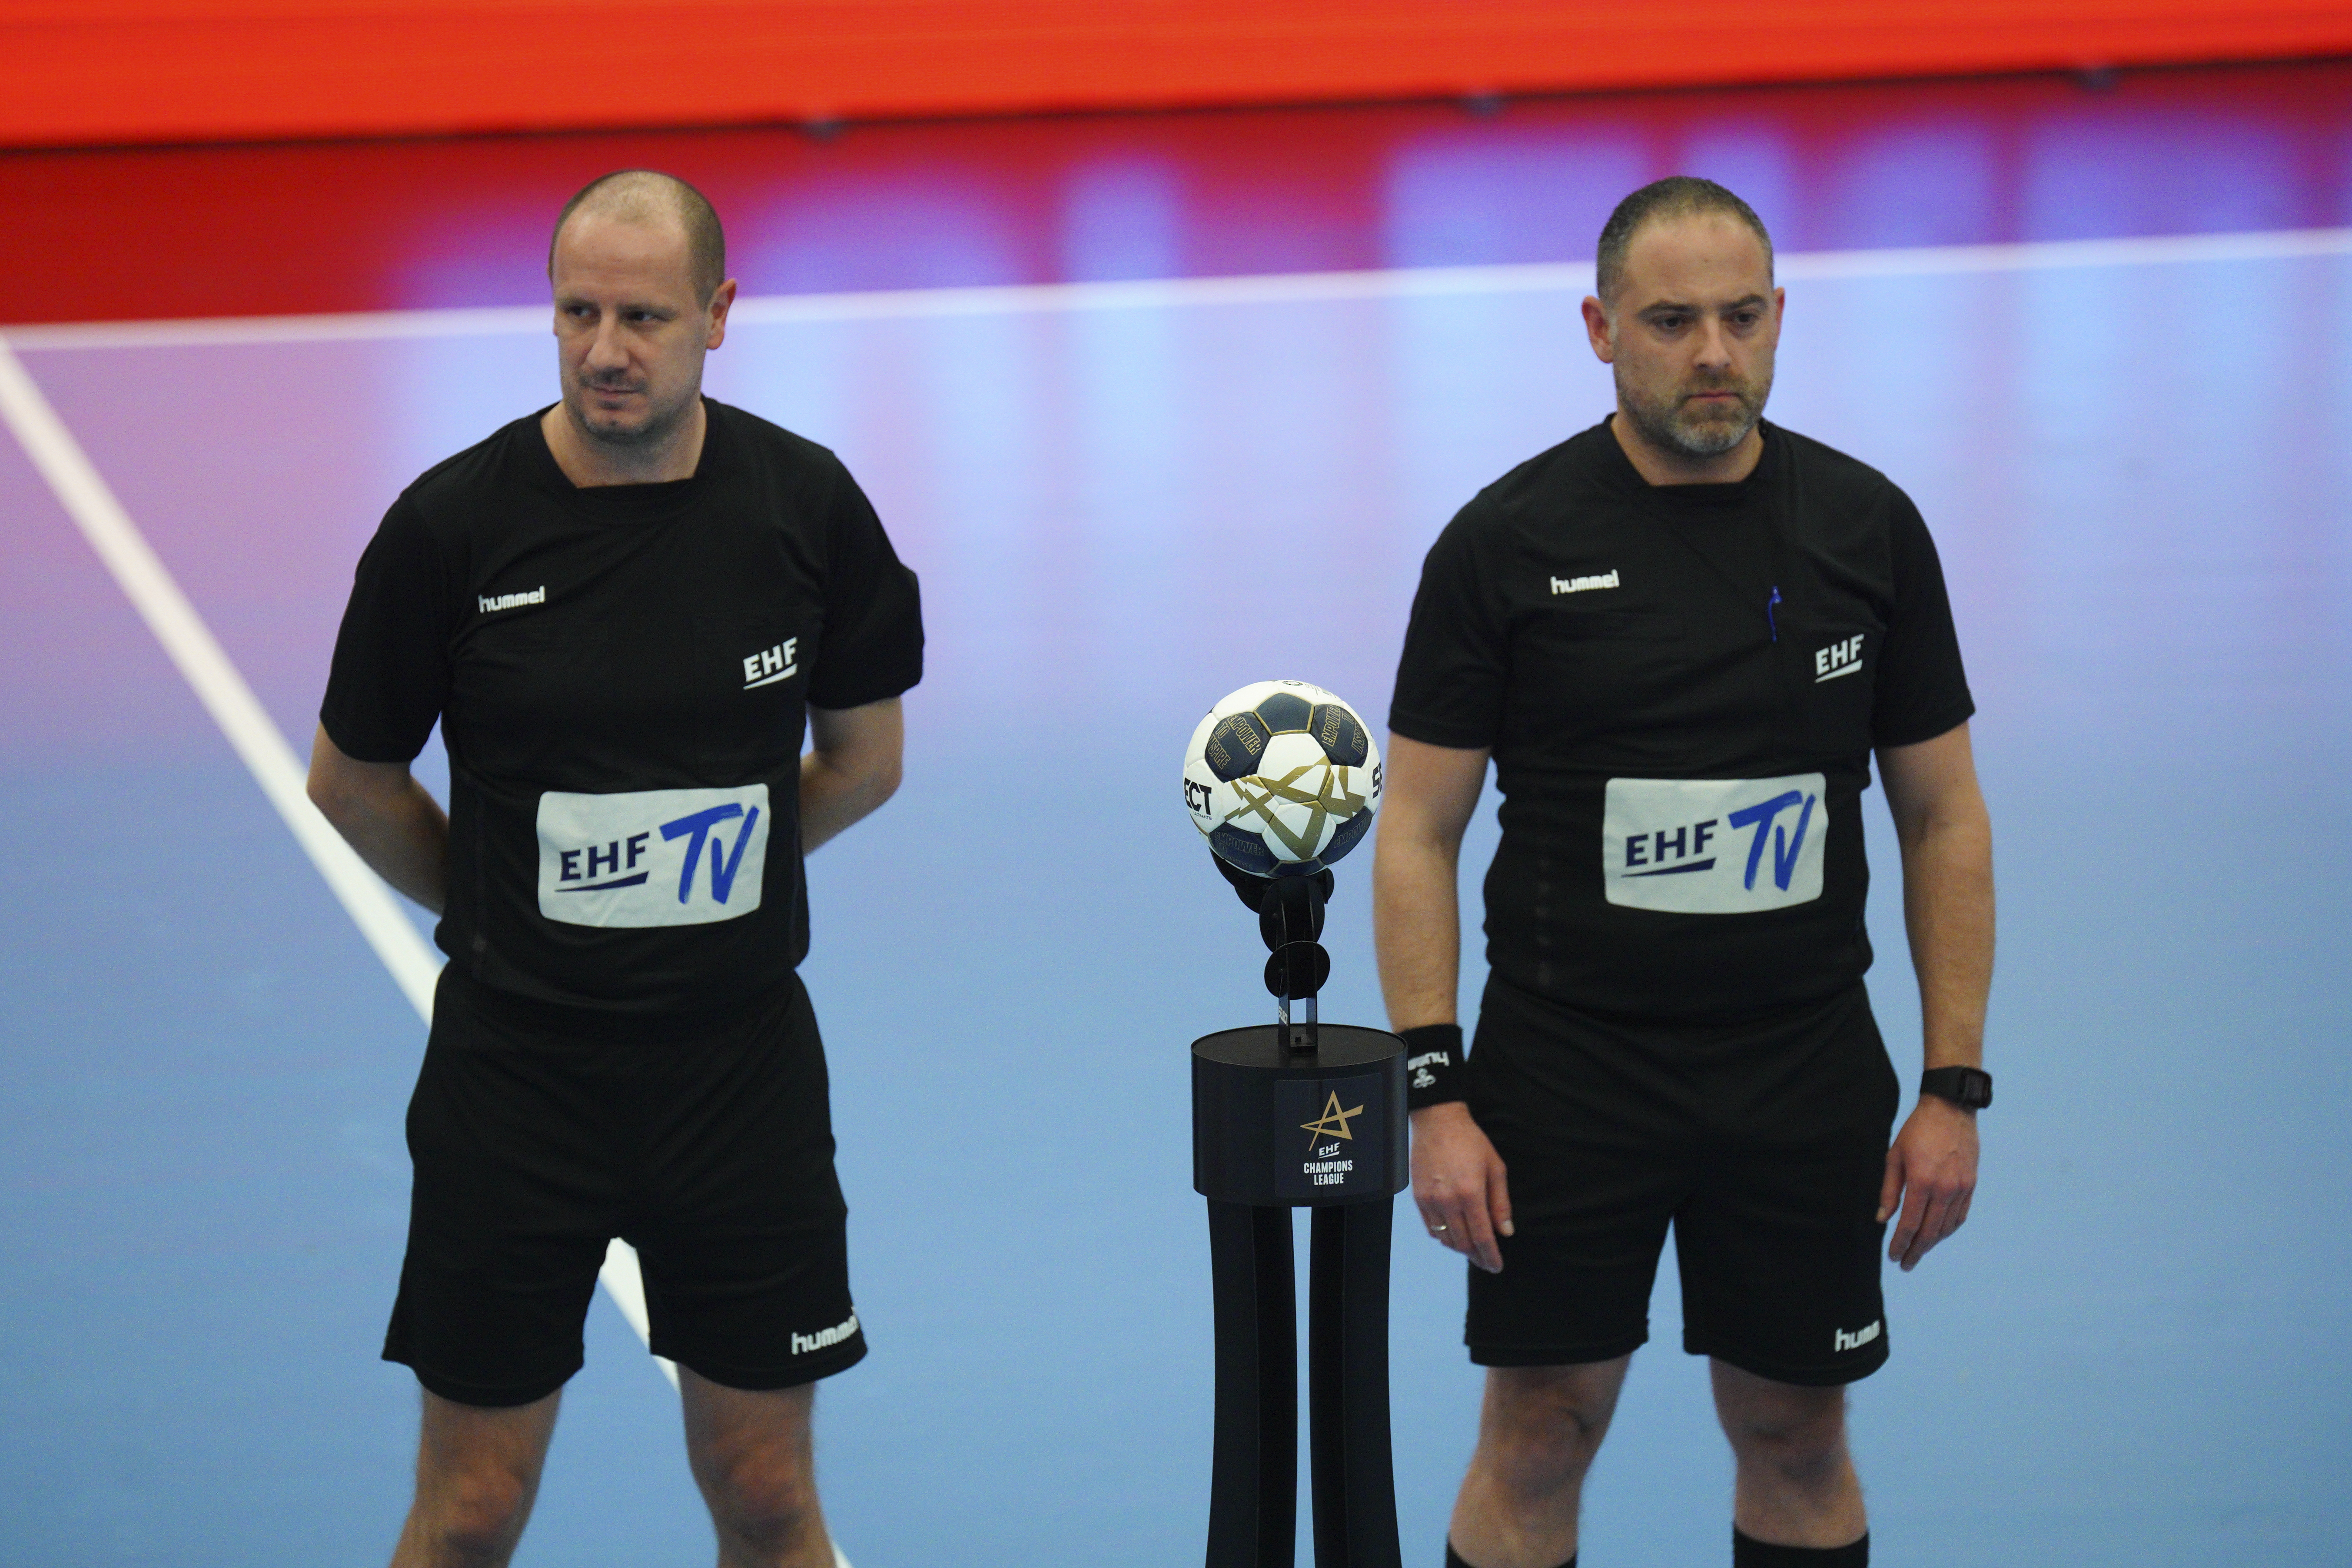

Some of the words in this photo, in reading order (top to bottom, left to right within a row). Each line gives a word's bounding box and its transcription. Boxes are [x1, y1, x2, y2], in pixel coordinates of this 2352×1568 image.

[1550, 569, 1620, 595] hummel
[478, 585, 545, 614] hummel
[743, 636, 798, 683] EHF
[1815, 633, 1864, 676] EHF
[1215, 721, 1230, 739] TO
[1227, 715, 1262, 755] EMPOWER
[560, 831, 649, 881] EHF
[659, 803, 759, 904] TV
[1626, 819, 1718, 867] EHF
[1728, 790, 1816, 891] TV
[1319, 1142, 1340, 1156] EHF
[1304, 1160, 1353, 1174] CHAMPIONS
[1314, 1173, 1344, 1186] LEAGUE
